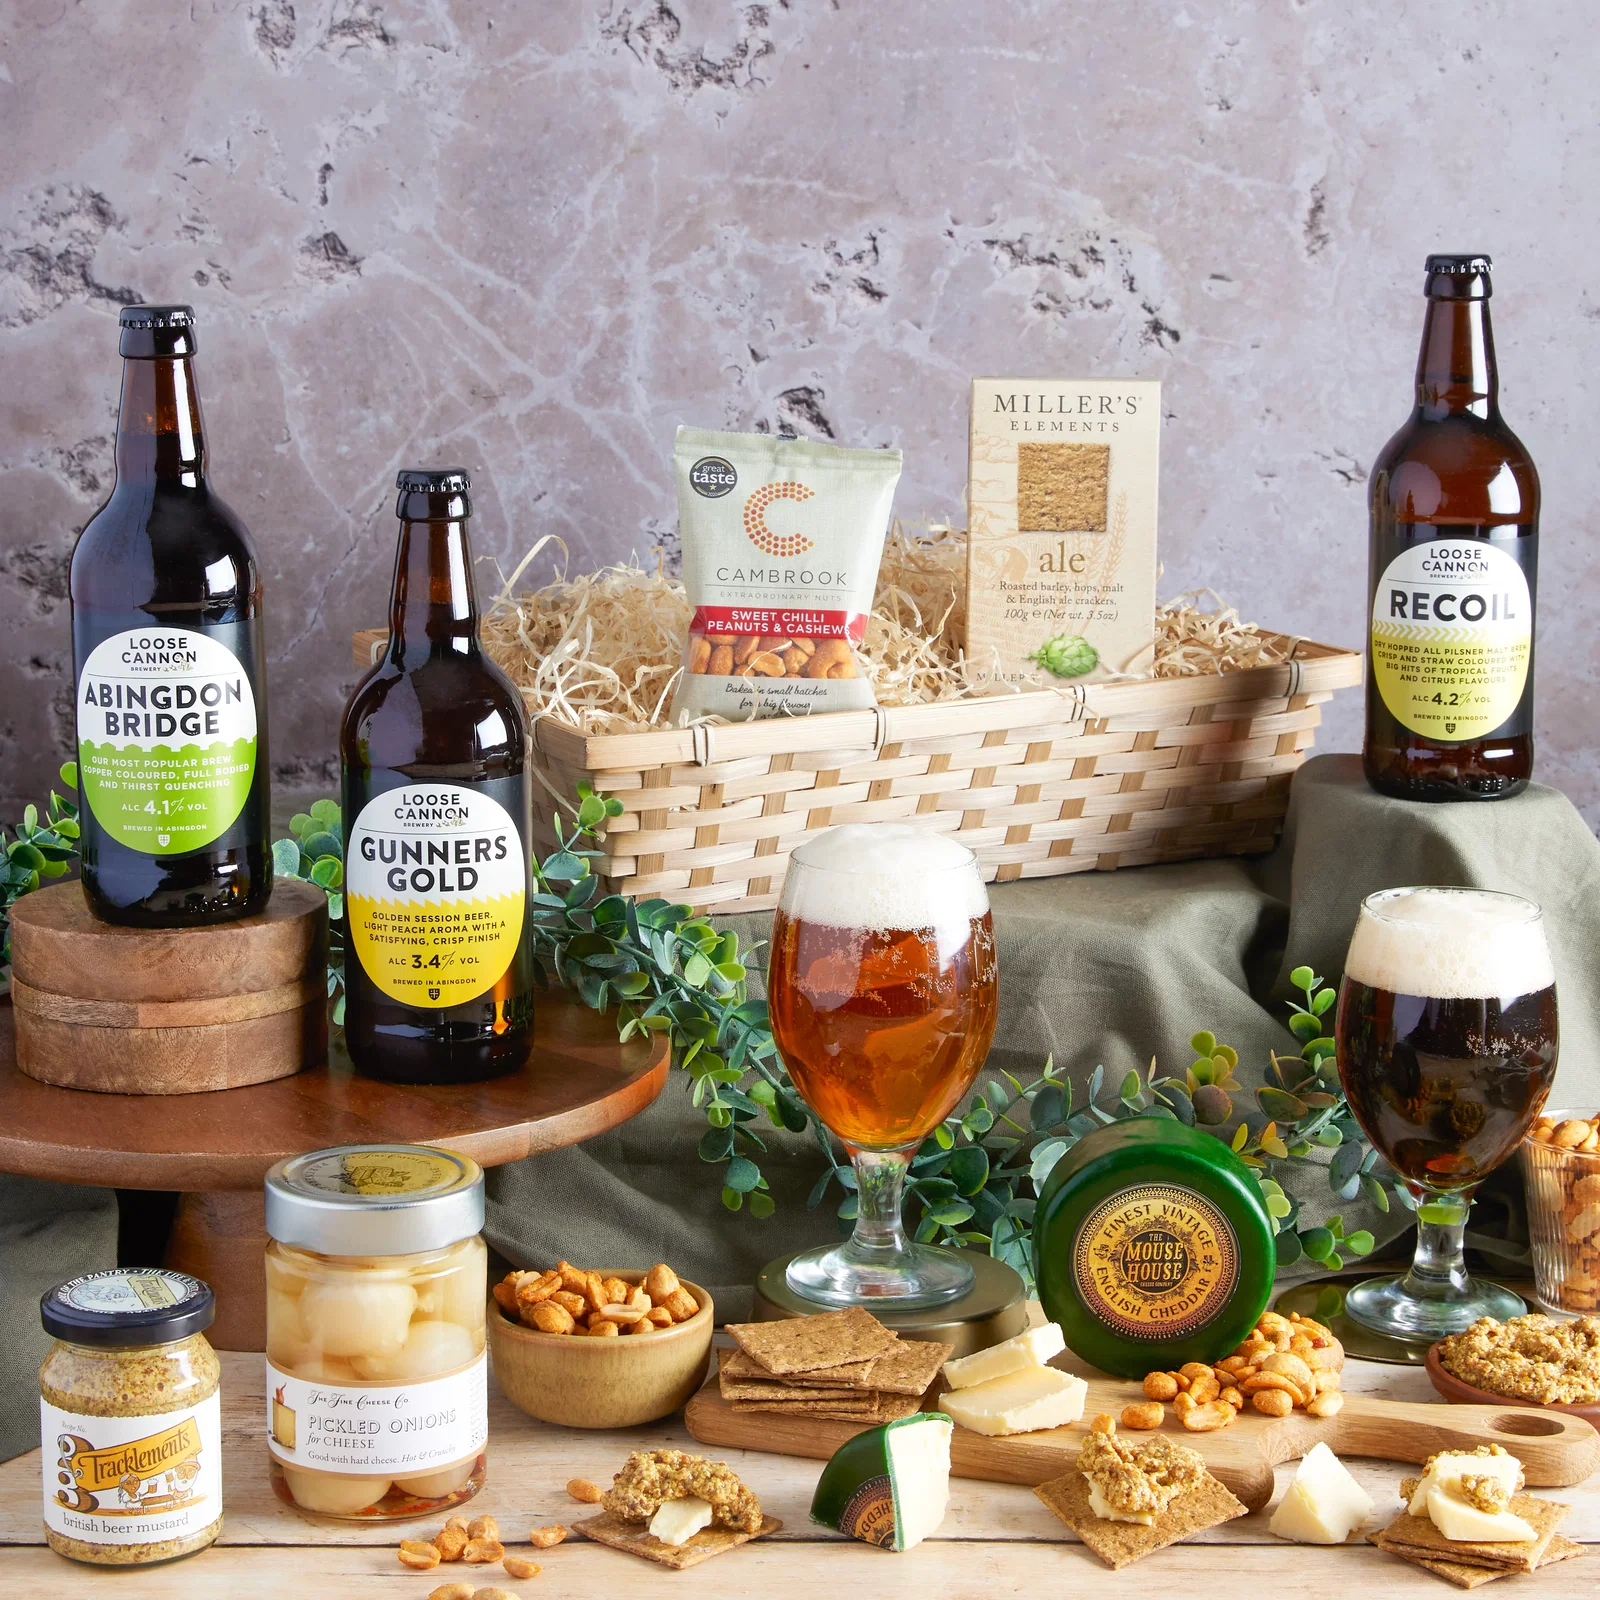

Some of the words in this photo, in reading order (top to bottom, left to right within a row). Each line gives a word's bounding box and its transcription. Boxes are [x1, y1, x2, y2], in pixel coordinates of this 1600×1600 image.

[993, 394, 1137, 415] MILLER'S
[1010, 420, 1119, 432] ELEMENTS
[702, 465, 725, 474] great
[692, 471, 735, 485] taste
[1039, 540, 1086, 573] ale
[1430, 548, 1482, 559] LOOSE
[1422, 560, 1489, 572] CANNON
[717, 567, 847, 586] CAMBROOK
[1000, 580, 1038, 591] Roasted
[1040, 581, 1071, 594] barley,
[1074, 582, 1100, 593] hops,
[1102, 583, 1124, 592] malt
[720, 591, 810, 600] EXTRAORDINARY
[1006, 594, 1017, 604] &
[1019, 595, 1056, 607] English
[1058, 595, 1073, 604] ale
[1075, 596, 1117, 605] crackers.
[1390, 589, 1516, 622] RECOIL
[731, 610, 777, 622] SWEET
[782, 612, 825, 623] CHILLI
[1004, 608, 1028, 621] 100g
[1043, 609, 1066, 620] (Net
[1068, 611, 1084, 619] wt.
[1087, 610, 1119, 623] 3.5oz)
[707, 621, 769, 632] PEANUTS
[773, 623, 782, 633] &
[786, 624, 850, 635] CASHEWS
[130, 637, 188, 650] LOOSE
[1374, 639, 1386, 649] DRY
[1388, 643, 1421, 653] HOPPED
[1423, 647, 1441, 655] ALL
[1444, 648, 1484, 656] PILSNER
[121, 650, 197, 664] CANNON
[1378, 650, 1398, 661] CRISP
[1400, 655, 1418, 663] AND
[1420, 657, 1454, 665] STRAW
[1457, 656, 1507, 665] COLOURED
[1509, 654, 1525, 662] WITH
[1386, 662, 1398, 670] BIG
[1401, 664, 1421, 673] HITS
[1424, 666, 1437, 674] OF
[1440, 667, 1488, 675] TROPICAL
[1490, 665, 1518, 674] FRUITS
[1399, 674, 1418, 683] AND
[1421, 676, 1455, 684] CITRUS
[1459, 676, 1507, 685] FLAVOURS
[84, 679, 242, 710] ABINGDON
[766, 684, 793, 695] small
[794, 685, 828, 696] batches
[739, 697, 753, 709] for
[763, 697, 778, 710] big
[1412, 694, 1429, 702] ALC
[1431, 690, 1473, 708] 4.2%
[1474, 695, 1491, 703] VOL
[105, 710, 220, 737] BRIDGE
[91, 755, 109, 766] OUR
[112, 759, 139, 768] MOST
[144, 759, 198, 768] POPULAR
[202, 755, 235, 766] BREW.
[83, 765, 112, 777] COPPER
[116, 770, 180, 780] COLOURED,
[184, 769, 212, 779] FULL
[215, 763, 249, 776] BODIED
[99, 779, 118, 789] AND
[122, 782, 160, 791] THIRST
[164, 778, 230, 791] QUENCHING
[121, 803, 140, 811] ALC
[143, 796, 185, 816] 4.1%
[187, 803, 208, 811] VOL
[403, 793, 461, 806] LOOSE
[394, 806, 469, 820] CANNON
[360, 835, 507, 866] GUNNERS
[387, 866, 479, 893] GOLD
[372, 911, 411, 922] GOLDEN
[414, 914, 460, 923] SESSION
[464, 911, 493, 921] BEER.
[364, 921, 388, 932] LIGHT
[391, 925, 425, 934] PEACH
[429, 925, 468, 934] AROMA
[472, 921, 497, 932] WITH
[500, 920, 506, 928] A
[369, 933, 429, 946] SATISFYING,
[433, 937, 464, 945] CRISP
[468, 933, 500, 943] FINISH
[388, 957, 407, 965] ALC
[411, 950, 456, 970] 3.4%
[460, 957, 480, 965] VOL
[392, 978, 423, 986] BREWED
[436, 978, 477, 986] ABINGDON
[1104, 1203, 1151, 1239] FINEST
[1162, 1204, 1214, 1250] VINTAGE
[1149, 1233, 1163, 1241] THE
[1125, 1241, 1184, 1261] MOUSE
[67, 1276, 85, 1287] THE
[86, 1268, 130, 1281] PANTRY
[1126, 1262, 1182, 1283] HOUSE
[1096, 1266, 1142, 1316] ENGLISH
[1149, 1278, 1211, 1319] CHEDDAR
[62, 1420, 76, 1433] Recipe
[77, 1424, 87, 1433] No.
[308, 1413, 381, 1434] PICKLED
[388, 1408, 457, 1434] ONIONS
[305, 1432, 321, 1445] for
[323, 1436, 375, 1449] CHEESE
[78, 1424, 190, 1484] Tracklements
[308, 1450, 329, 1462] Good
[330, 1454, 349, 1464] with
[350, 1455, 369, 1465] hard
[371, 1456, 400, 1465] cheese.
[401, 1453, 417, 1463] Hot
[418, 1451, 427, 1460] &
[63, 1511, 99, 1533] british
[102, 1520, 133, 1534] beer
[136, 1511, 189, 1533] mustard
